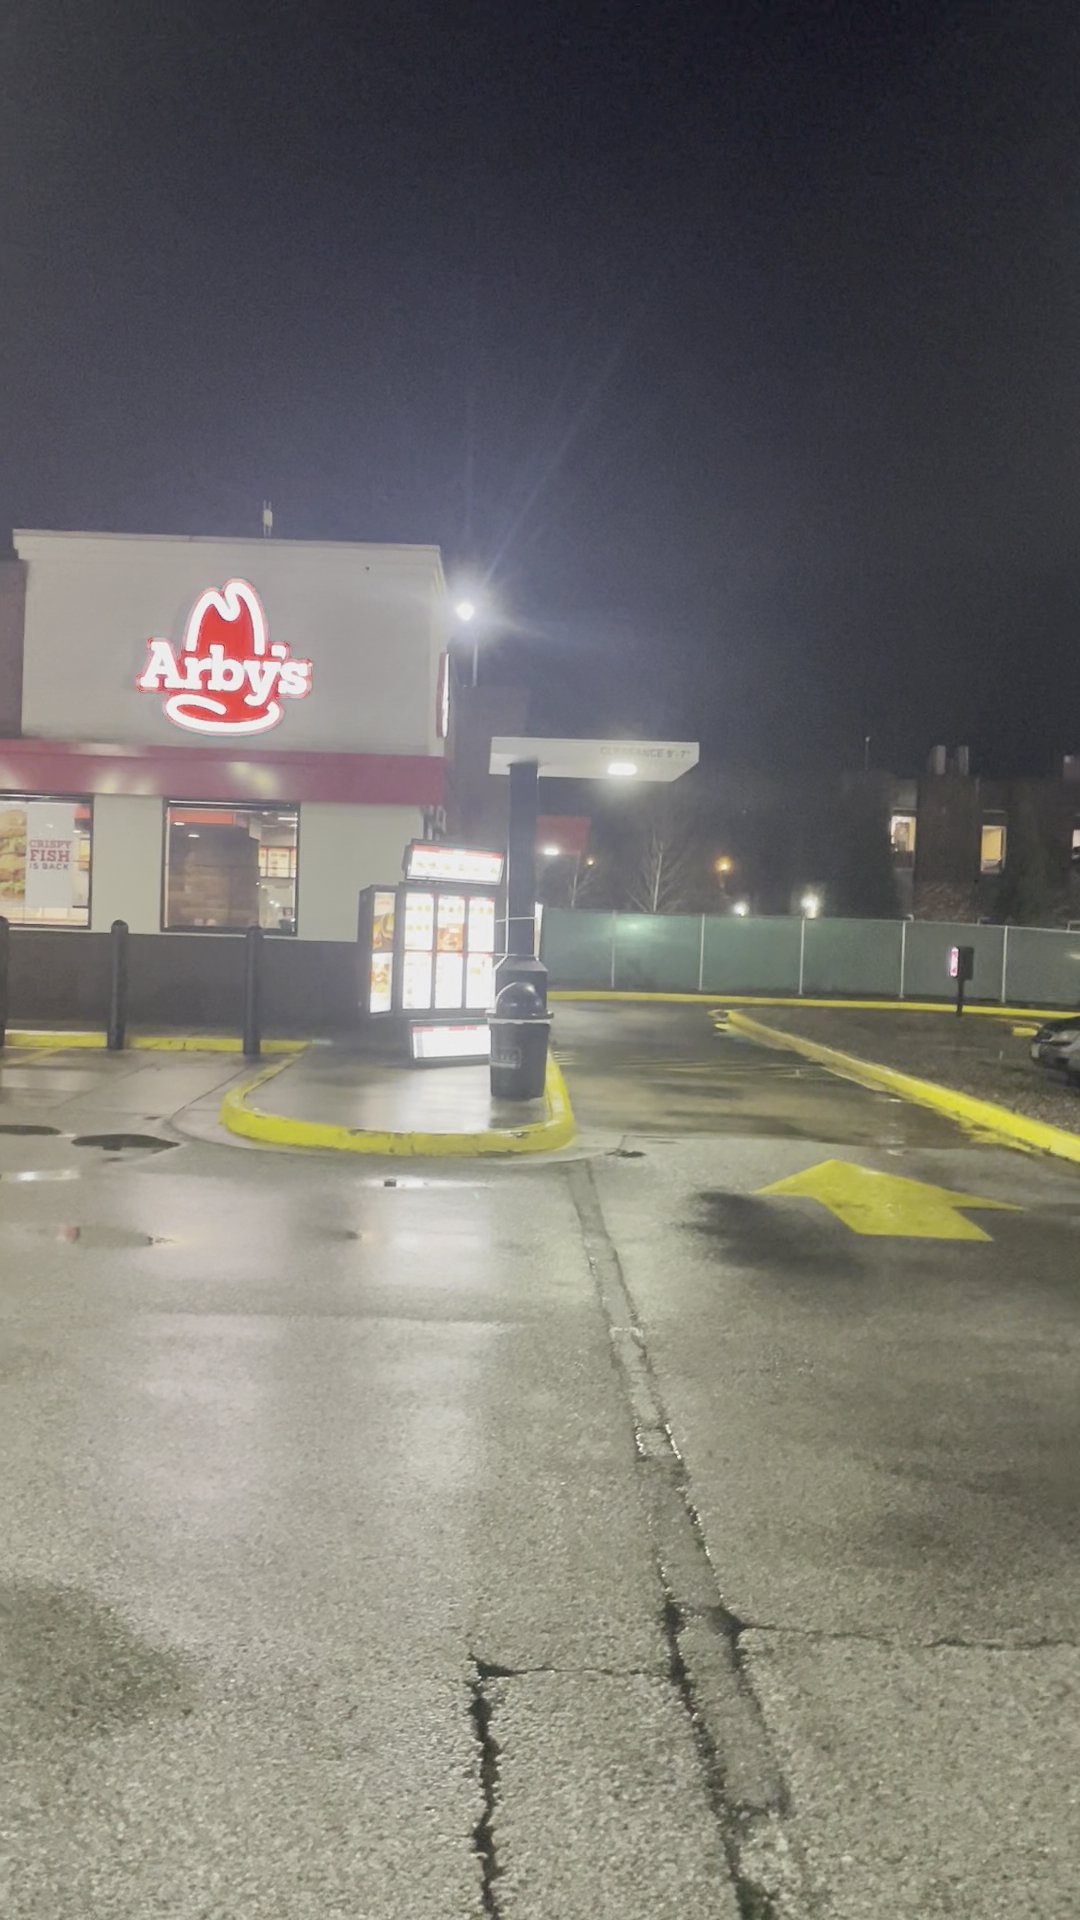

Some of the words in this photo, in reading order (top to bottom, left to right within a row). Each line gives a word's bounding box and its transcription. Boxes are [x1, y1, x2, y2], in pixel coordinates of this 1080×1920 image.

[138, 640, 312, 706] Arby's
[29, 839, 72, 849] CRISPY
[30, 849, 70, 862] FISH
[29, 862, 39, 870] IS
[42, 862, 69, 871] BACK
